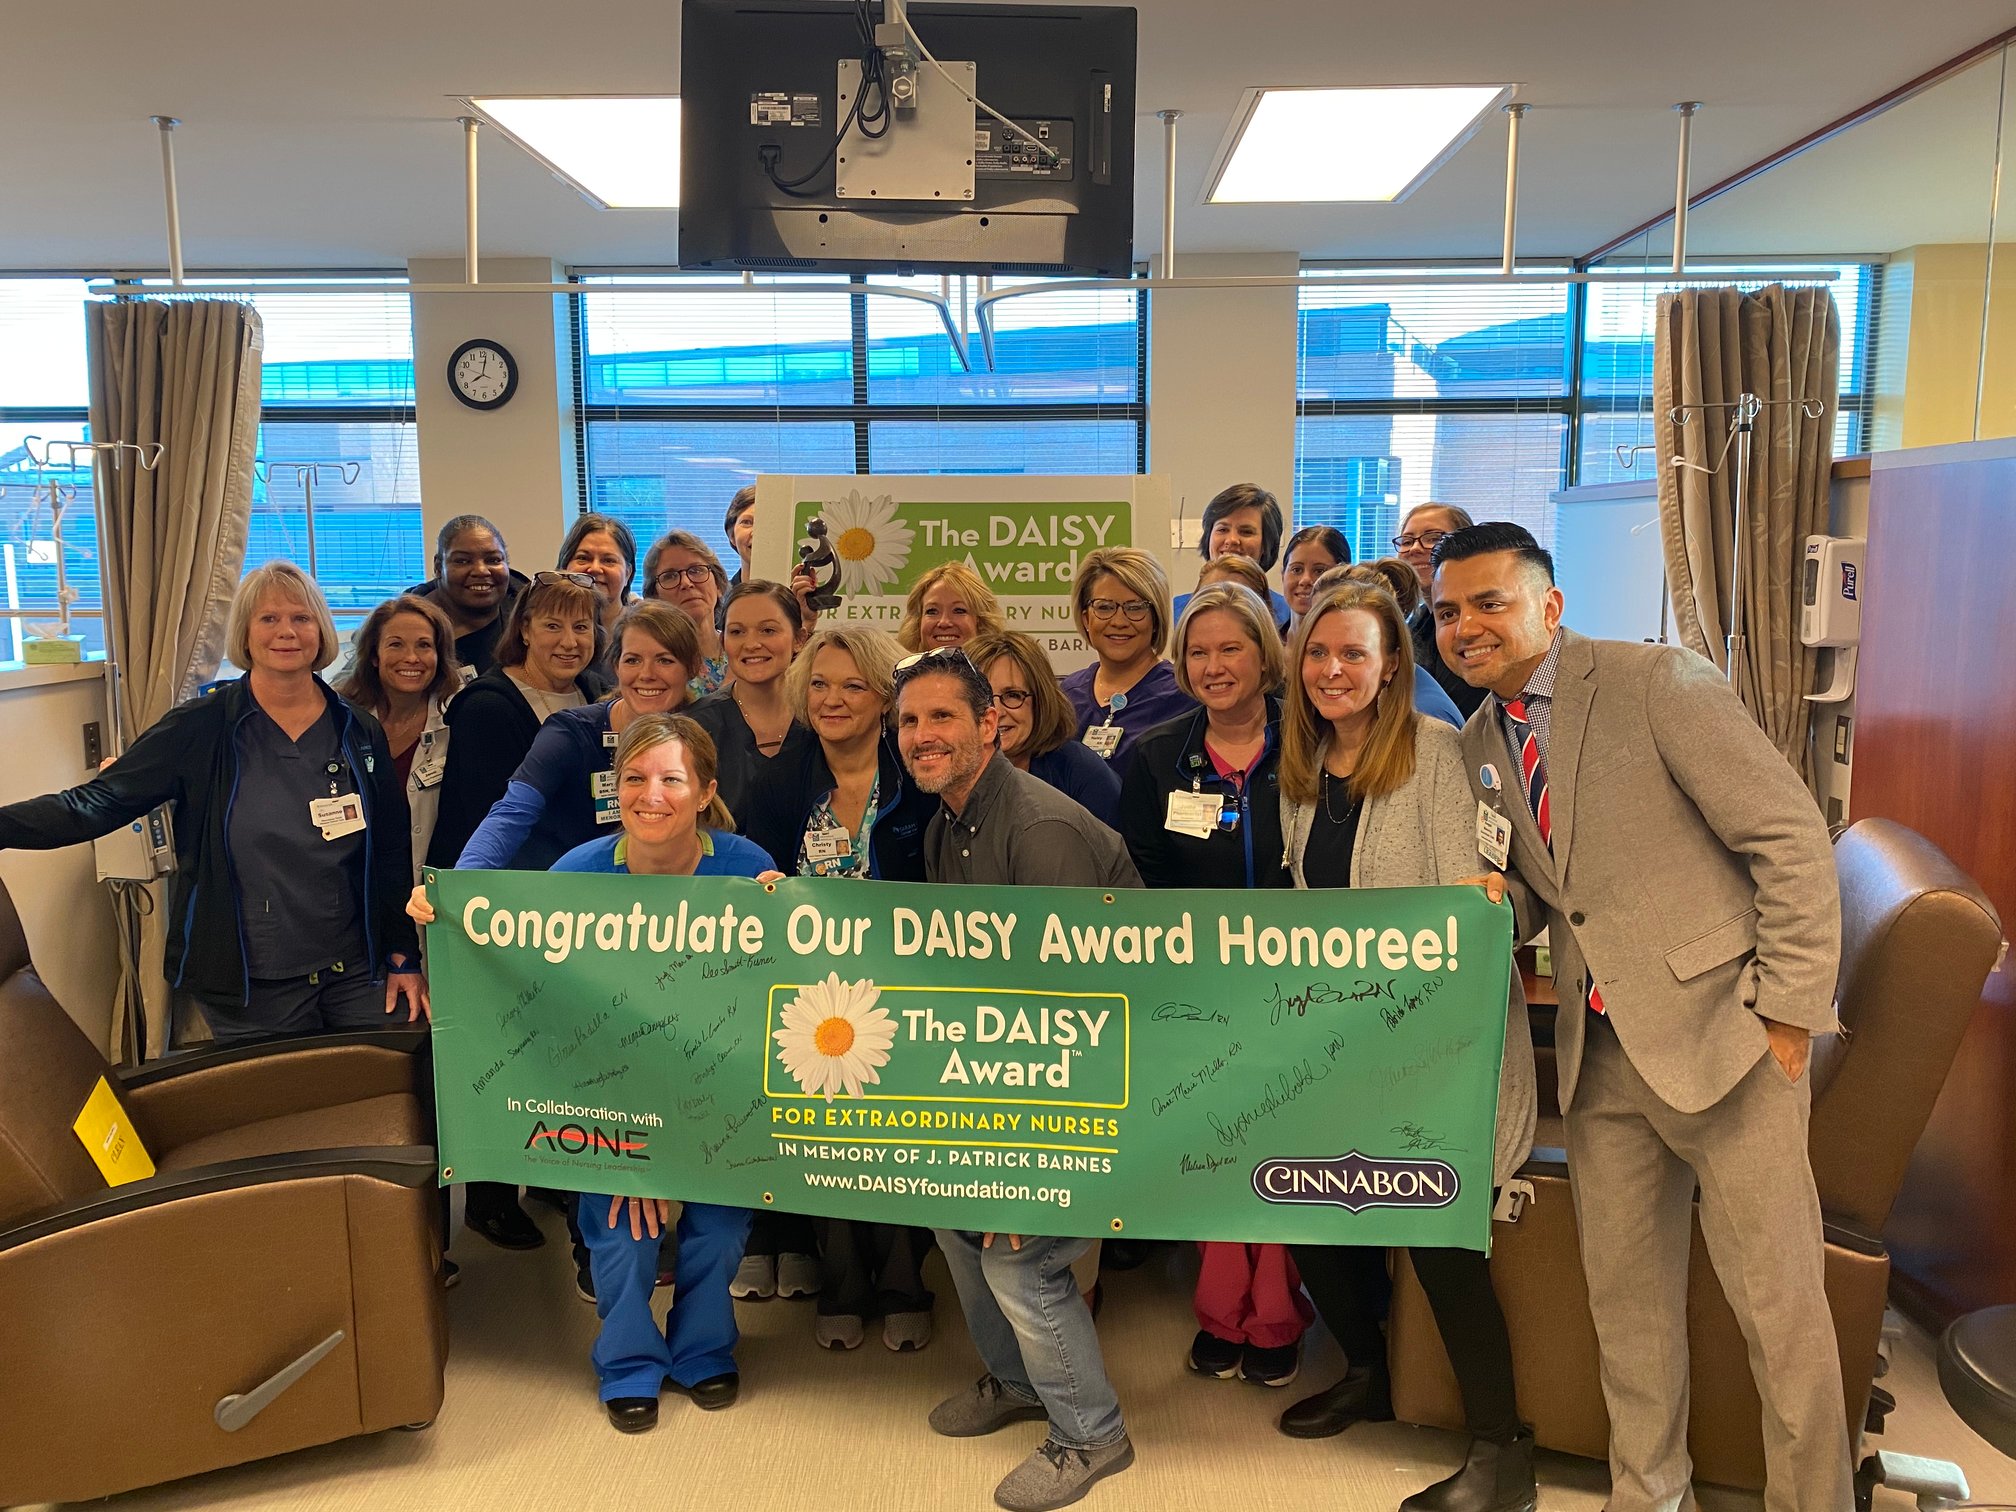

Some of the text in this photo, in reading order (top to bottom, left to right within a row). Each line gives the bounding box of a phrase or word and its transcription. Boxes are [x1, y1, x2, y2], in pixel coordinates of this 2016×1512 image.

[919, 514, 1116, 547] The DAISY
[962, 550, 1078, 583] Award
[1842, 566, 1855, 596] Purell
[811, 841, 832, 849] Christy
[824, 857, 841, 869] RN
[463, 896, 1458, 971] Congratulate Our DAISY Award Honoree!
[902, 1008, 966, 1042] The
[976, 1005, 1110, 1046] DAISY
[507, 1097, 663, 1128] In Collaboration with
[772, 1106, 817, 1125] FOR
[825, 1108, 1022, 1131] EXTRAORDINARY
[1031, 1114, 1119, 1137] NURSES
[524, 1120, 651, 1160] AONE
[523, 1154, 537, 1164] The
[540, 1155, 561, 1166] Voice
[561, 1158, 570, 1166] of
[571, 1160, 602, 1171] Nursing
[778, 1142, 1112, 1174] IN MEMORY OF J. PATRICK BARNES
[804, 1173, 1071, 1207] www.DAISYfoundation.org
